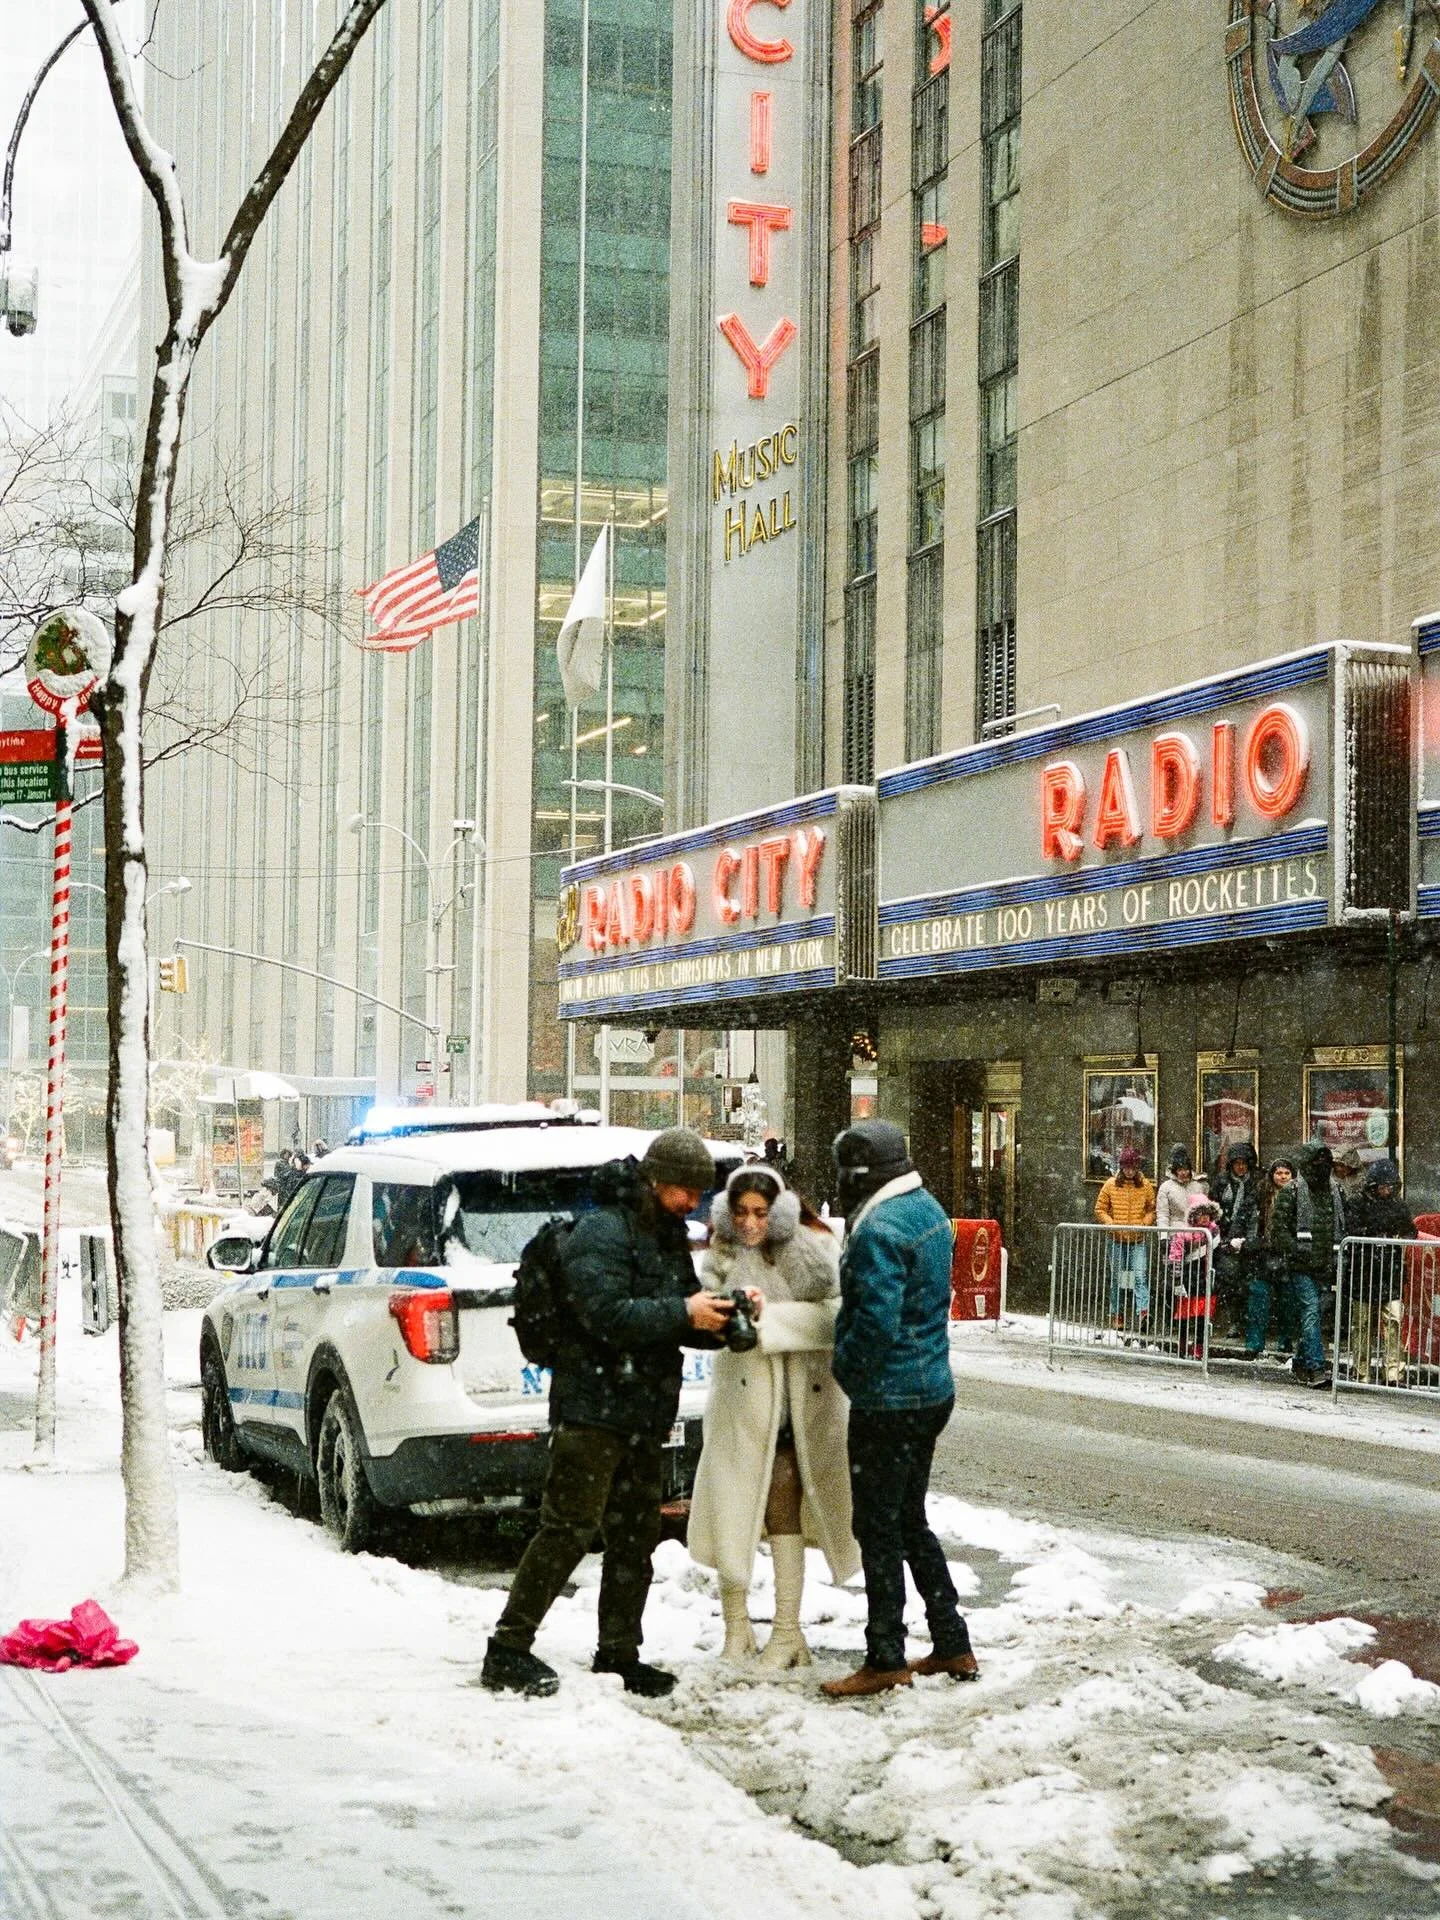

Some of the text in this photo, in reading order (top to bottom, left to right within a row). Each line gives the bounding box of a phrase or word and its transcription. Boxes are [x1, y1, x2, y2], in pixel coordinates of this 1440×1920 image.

[716, 0, 797, 400] CITY
[713, 423, 798, 505] MUSIC
[724, 489, 797, 564] HALL
[31, 682, 58, 710] Happy
[0, 736, 25, 748] ytime
[20, 765, 48, 775] service
[17, 776, 48, 788] location
[1041, 702, 1310, 862] RADIO
[585, 826, 825, 951] RADIO CITY
[891, 859, 1318, 955] CELEBRATE 100 YEARS OF ROCKETTES
[564, 940, 823, 1000] NOW PLAYING THIS IS CHRISTMAS IN NEW YORK
[600, 1036, 653, 1054] VRA
